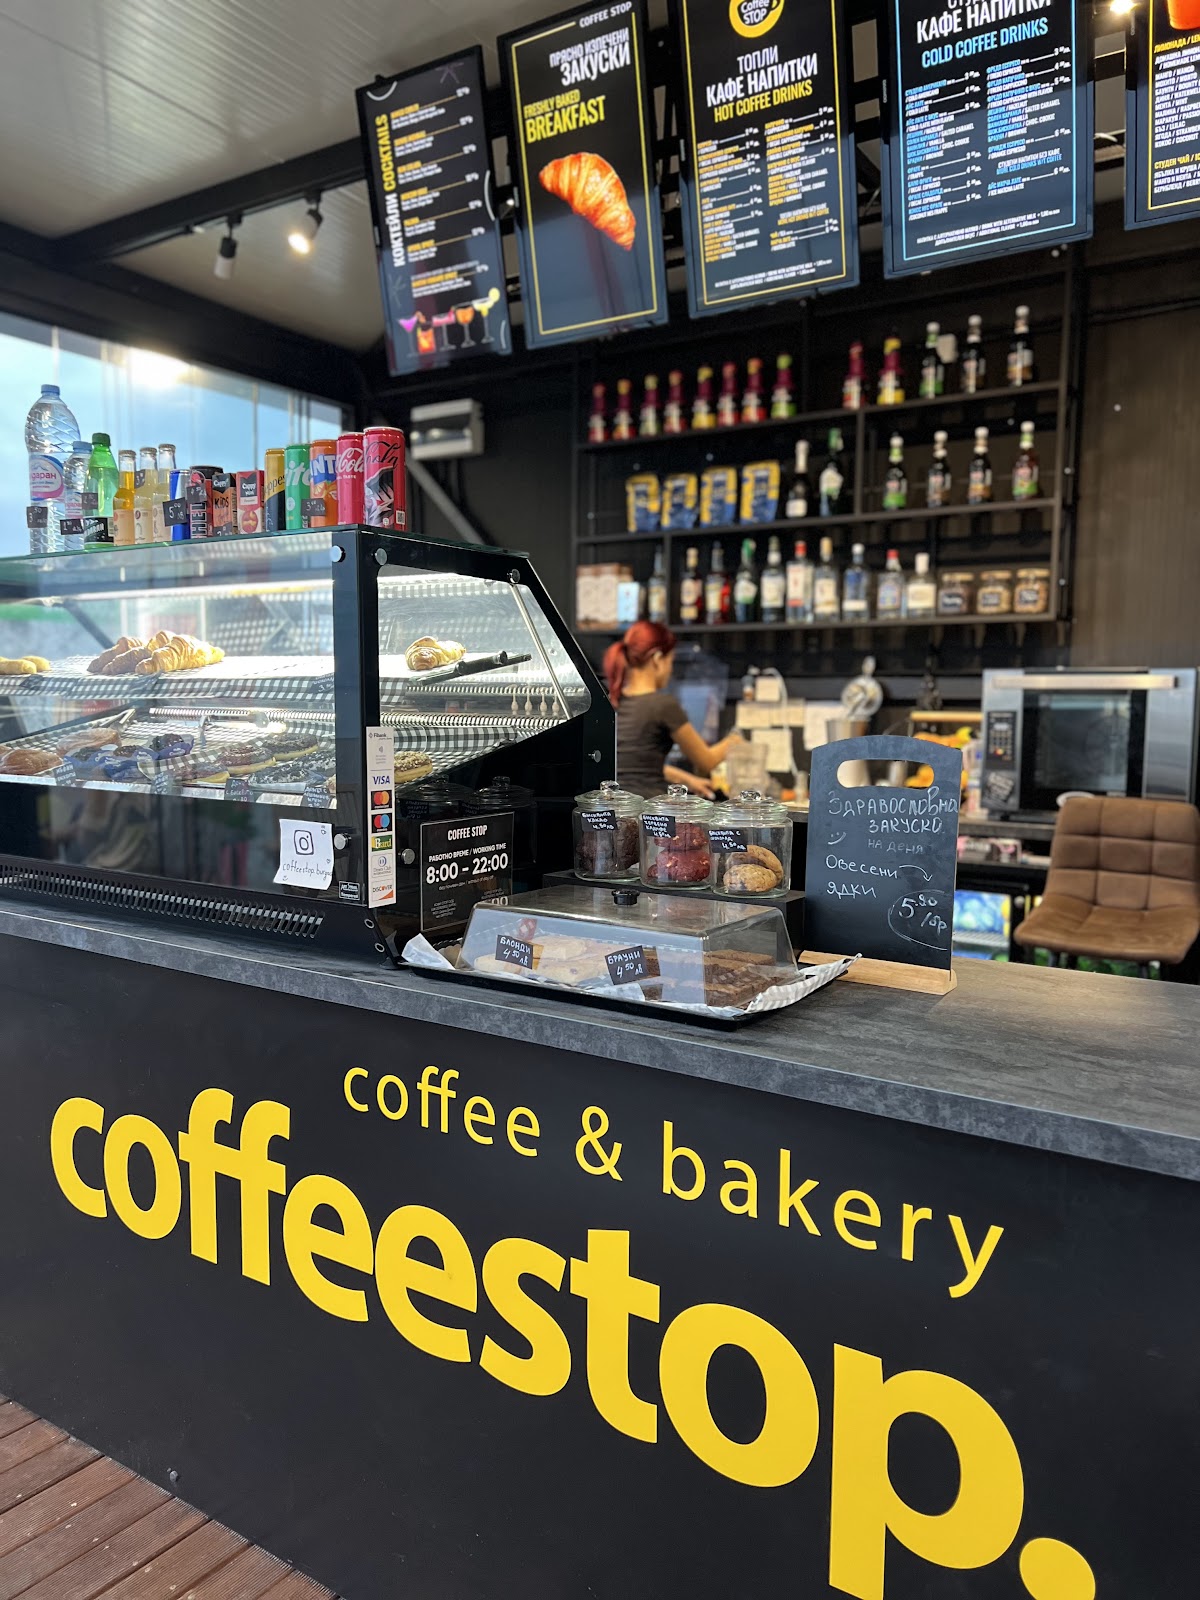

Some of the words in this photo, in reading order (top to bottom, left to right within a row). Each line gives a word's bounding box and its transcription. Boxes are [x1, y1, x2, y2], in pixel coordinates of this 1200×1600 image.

[579, 9, 608, 28] COFFEE
[611, 1, 632, 17] STOP
[743, 8, 767, 24] STOP
[917, 9, 962, 43] КАФЕ
[922, 45, 952, 68] COLD
[955, 31, 997, 58] COFFEE
[1001, 17, 1048, 46] DRINKS
[560, 42, 631, 86] ЗАКУСКИ
[737, 45, 778, 73] ТОПЛИ
[706, 76, 744, 107] КАФЕ
[747, 53, 817, 95] НАПИТКИ
[523, 97, 555, 119] FRESHLY
[555, 89, 580, 109] BAKED
[714, 103, 734, 123] HOT
[736, 92, 771, 116] COFFEE
[773, 79, 812, 105] DRINKS
[525, 95, 605, 143] BREAKFAST
[375, 114, 396, 192] COCKTAILS
[1178, 154, 1189, 164] ЧАЙ
[385, 193, 406, 268] КОКТЕЙЛИ
[373, 776, 391, 785] VISA
[448, 827, 470, 840] COFFEE
[472, 825, 488, 836] STOP
[473, 844, 496, 854] WORKING
[496, 842, 506, 850] TIME
[426, 862, 458, 884] 8:00
[472, 853, 508, 875] 22:00
[500, 936, 531, 954] БЛОНДИ
[608, 951, 641, 965] БРАУНИ
[343, 1065, 539, 1157] coffee
[575, 1106, 622, 1182] &
[663, 1121, 1004, 1298] bakery
[50, 1087, 1096, 1600] coffeestop.
